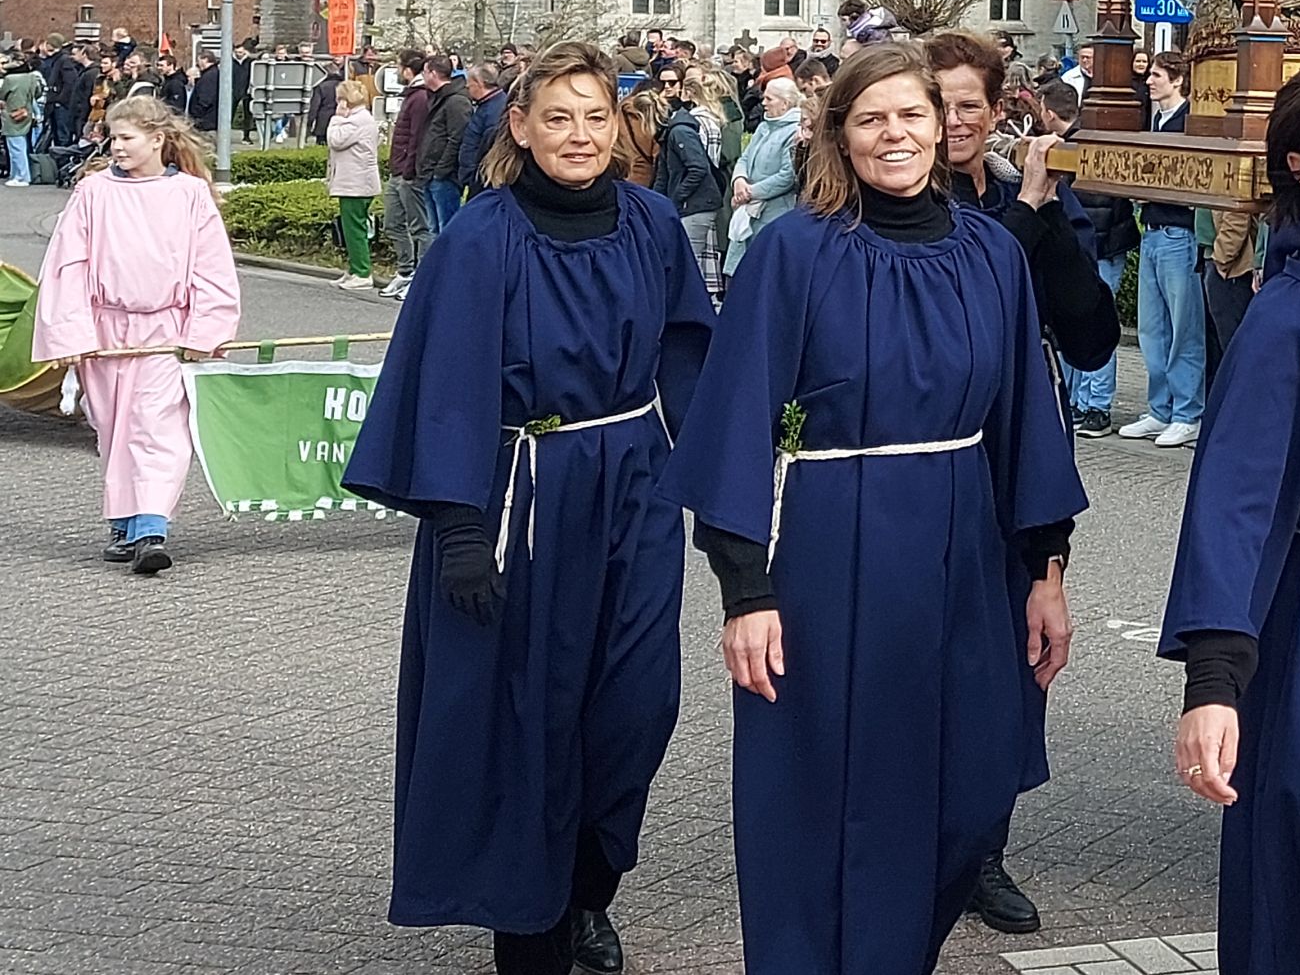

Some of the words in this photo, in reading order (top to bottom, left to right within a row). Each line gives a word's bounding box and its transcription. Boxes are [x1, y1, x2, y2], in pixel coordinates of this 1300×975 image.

[1140, 7, 1155, 15] MAX
[1156, 0, 1176, 16] 30
[298, 440, 345, 464] VAN
